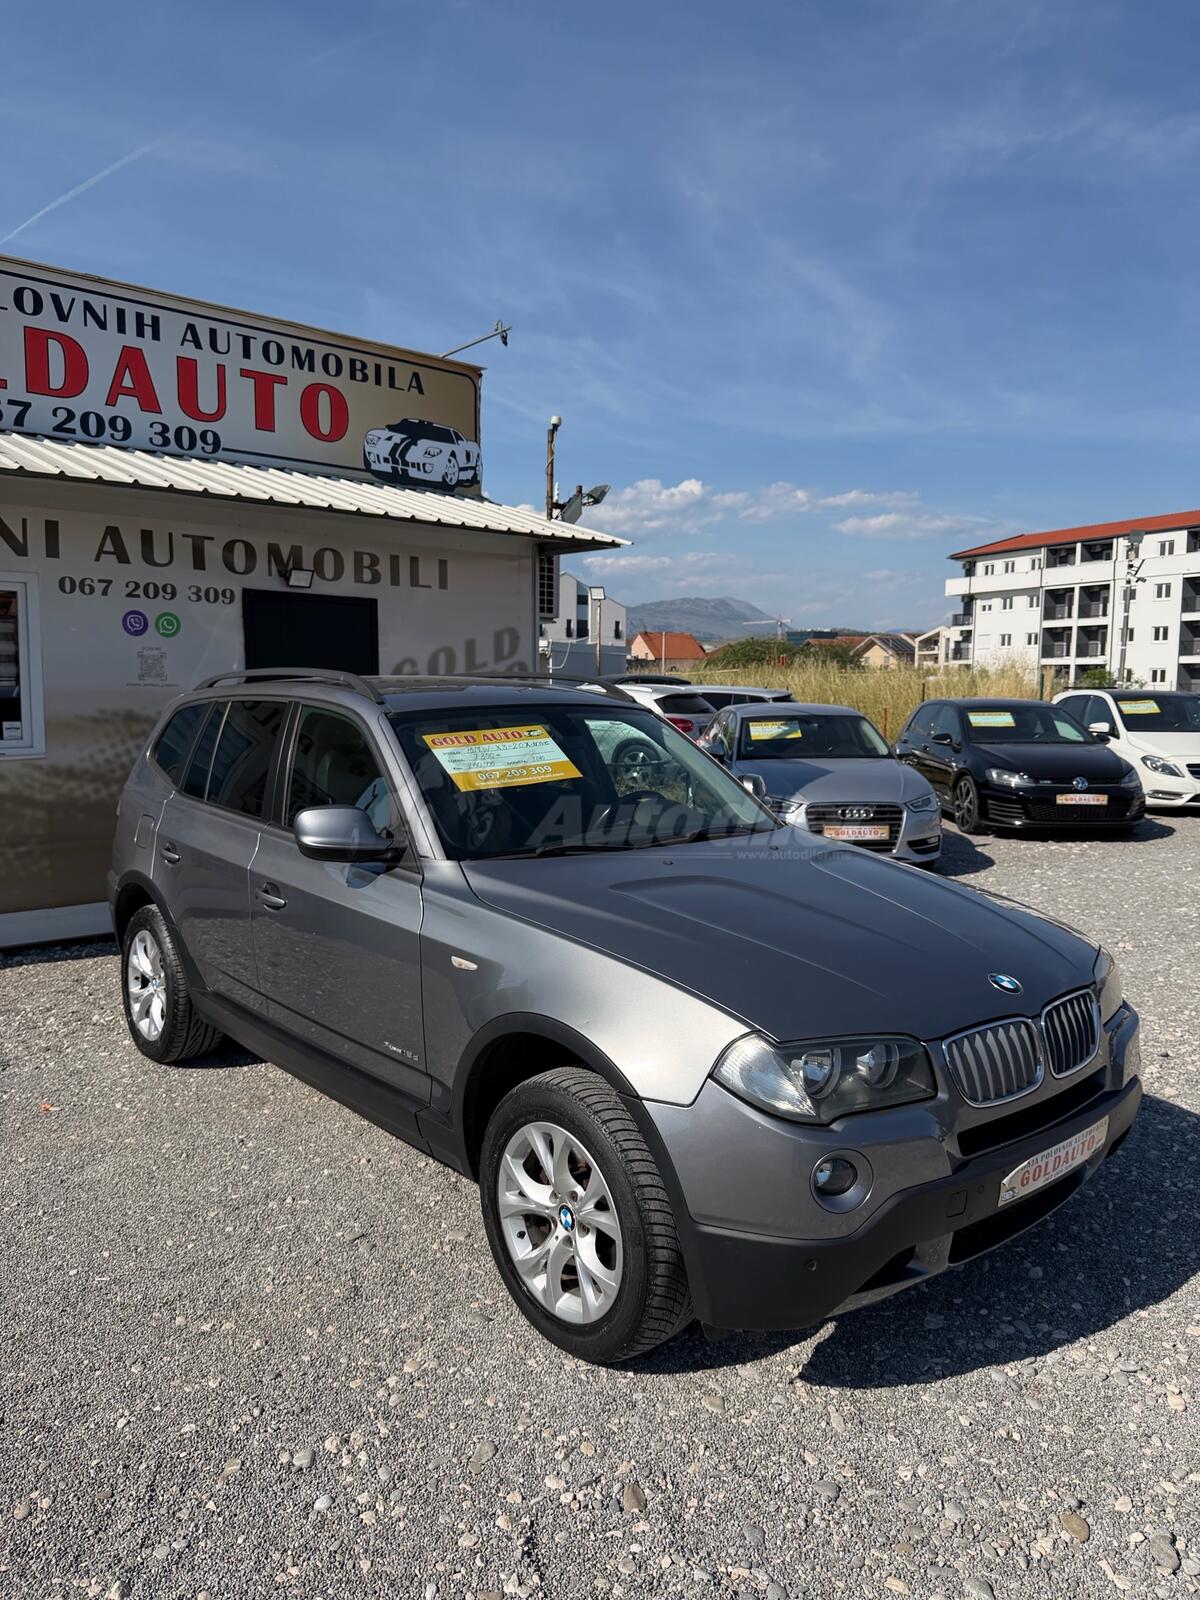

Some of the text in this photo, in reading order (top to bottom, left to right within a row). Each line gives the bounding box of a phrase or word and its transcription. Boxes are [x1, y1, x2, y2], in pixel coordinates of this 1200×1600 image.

[0, 286, 425, 395] OVNIH AUTOMOBILA
[0, 325, 349, 443] DAUTO
[0, 399, 222, 454] 7 209 309
[94, 526, 449, 591] AUTOMOBILI
[58, 576, 236, 605] 067 209 309
[391, 626, 521, 676] GOLD
[431, 731, 523, 746] GOLD AUTO
[478, 771, 500, 780] 067
[505, 768, 528, 778] 209
[529, 765, 552, 775] 309
[1020, 1135, 1096, 1188] GOLDAUTO
